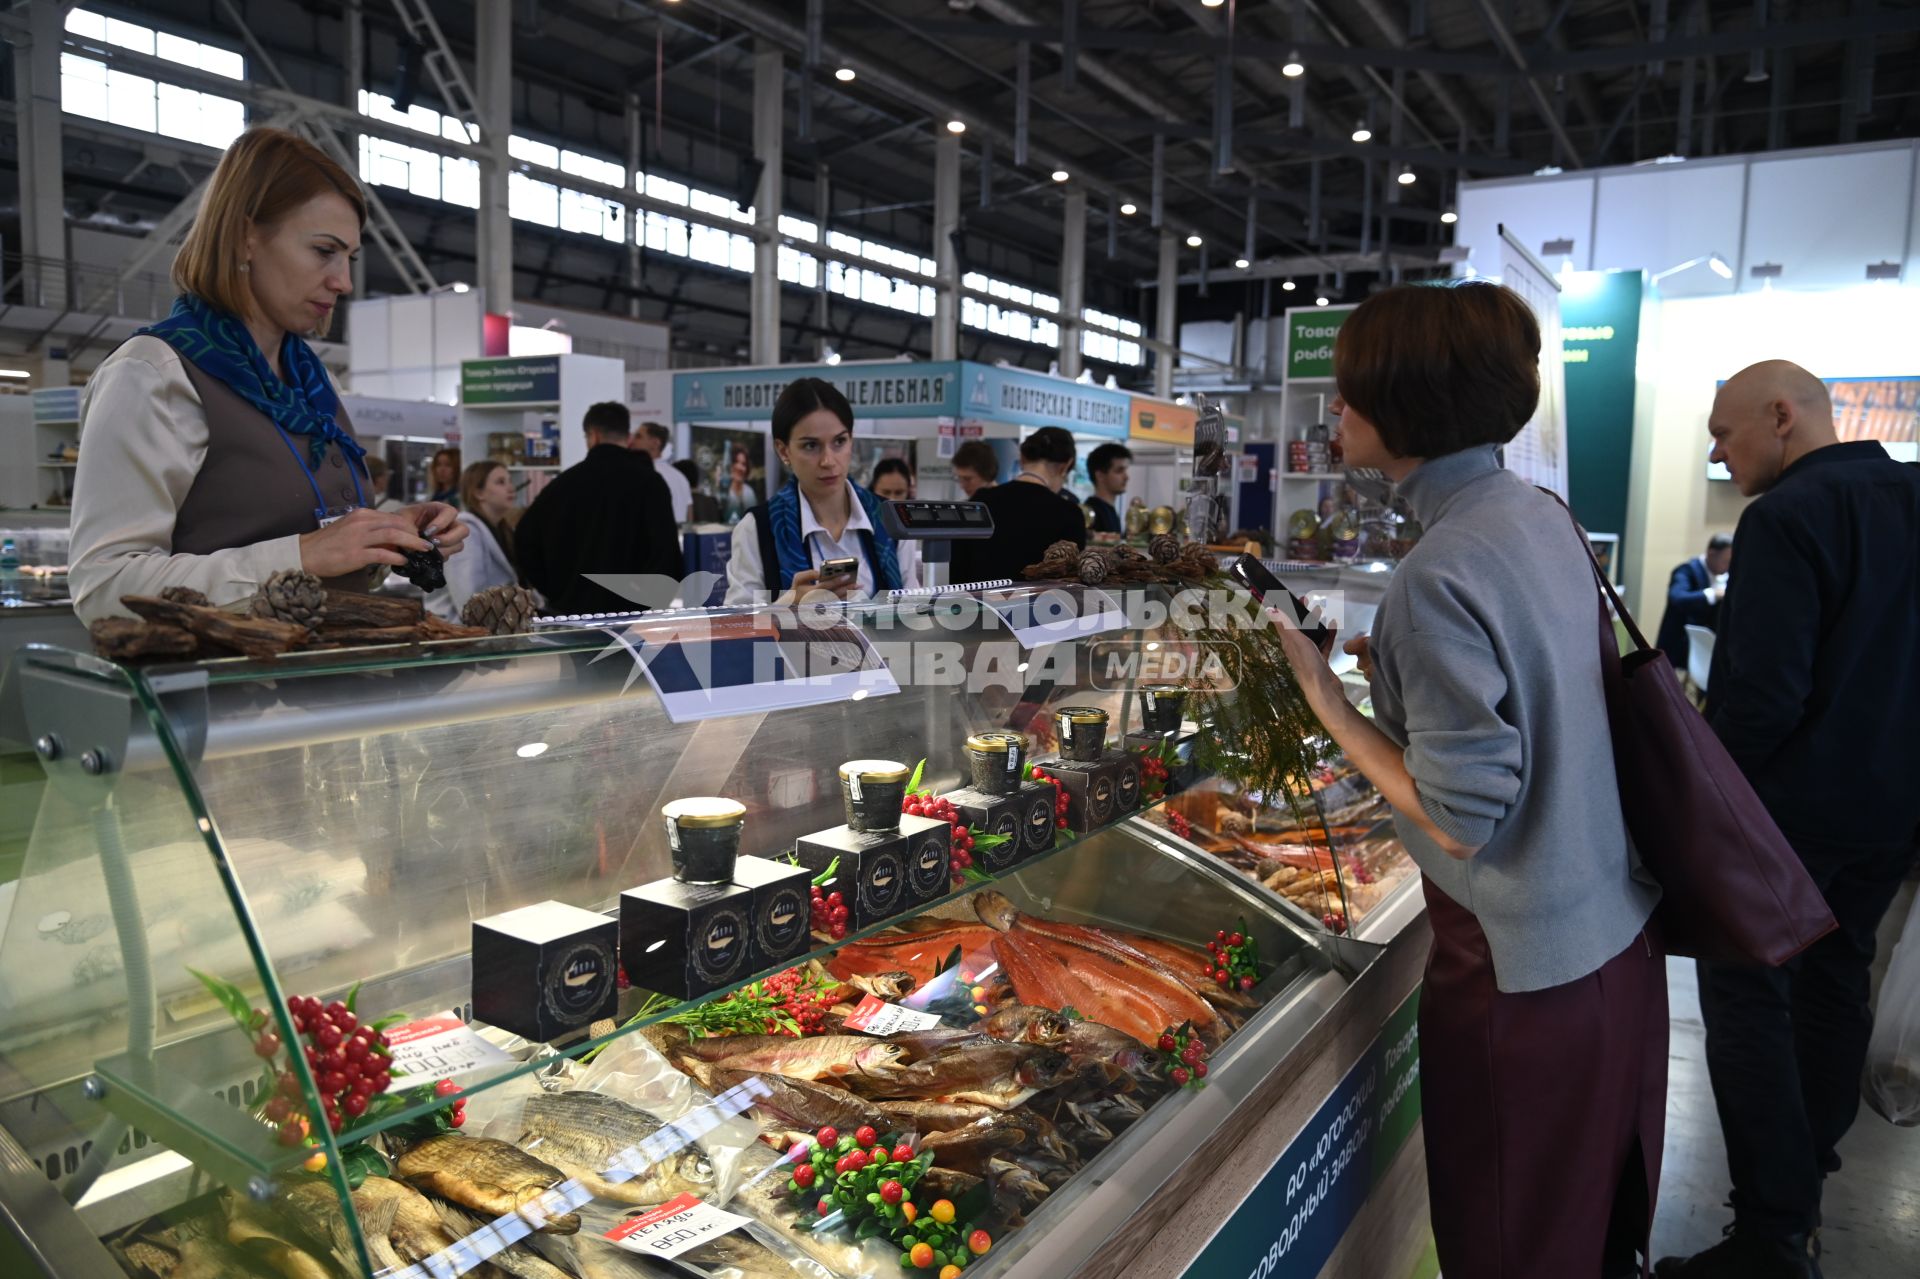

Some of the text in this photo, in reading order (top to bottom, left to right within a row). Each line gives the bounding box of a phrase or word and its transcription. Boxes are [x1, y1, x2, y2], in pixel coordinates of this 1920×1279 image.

[724, 378, 944, 407] НОВОТЕ ЦЕЛЕБНАЯ
[1001, 384, 1124, 425] НОВОТЕРСКАЯ ЦЕЛЕБНАЯ
[1286, 1064, 1376, 1206] АО «ЮГОРСКИЙ
[651, 1228, 697, 1250] 850
[1248, 1166, 1329, 1279] ОВОДНЫЙ
